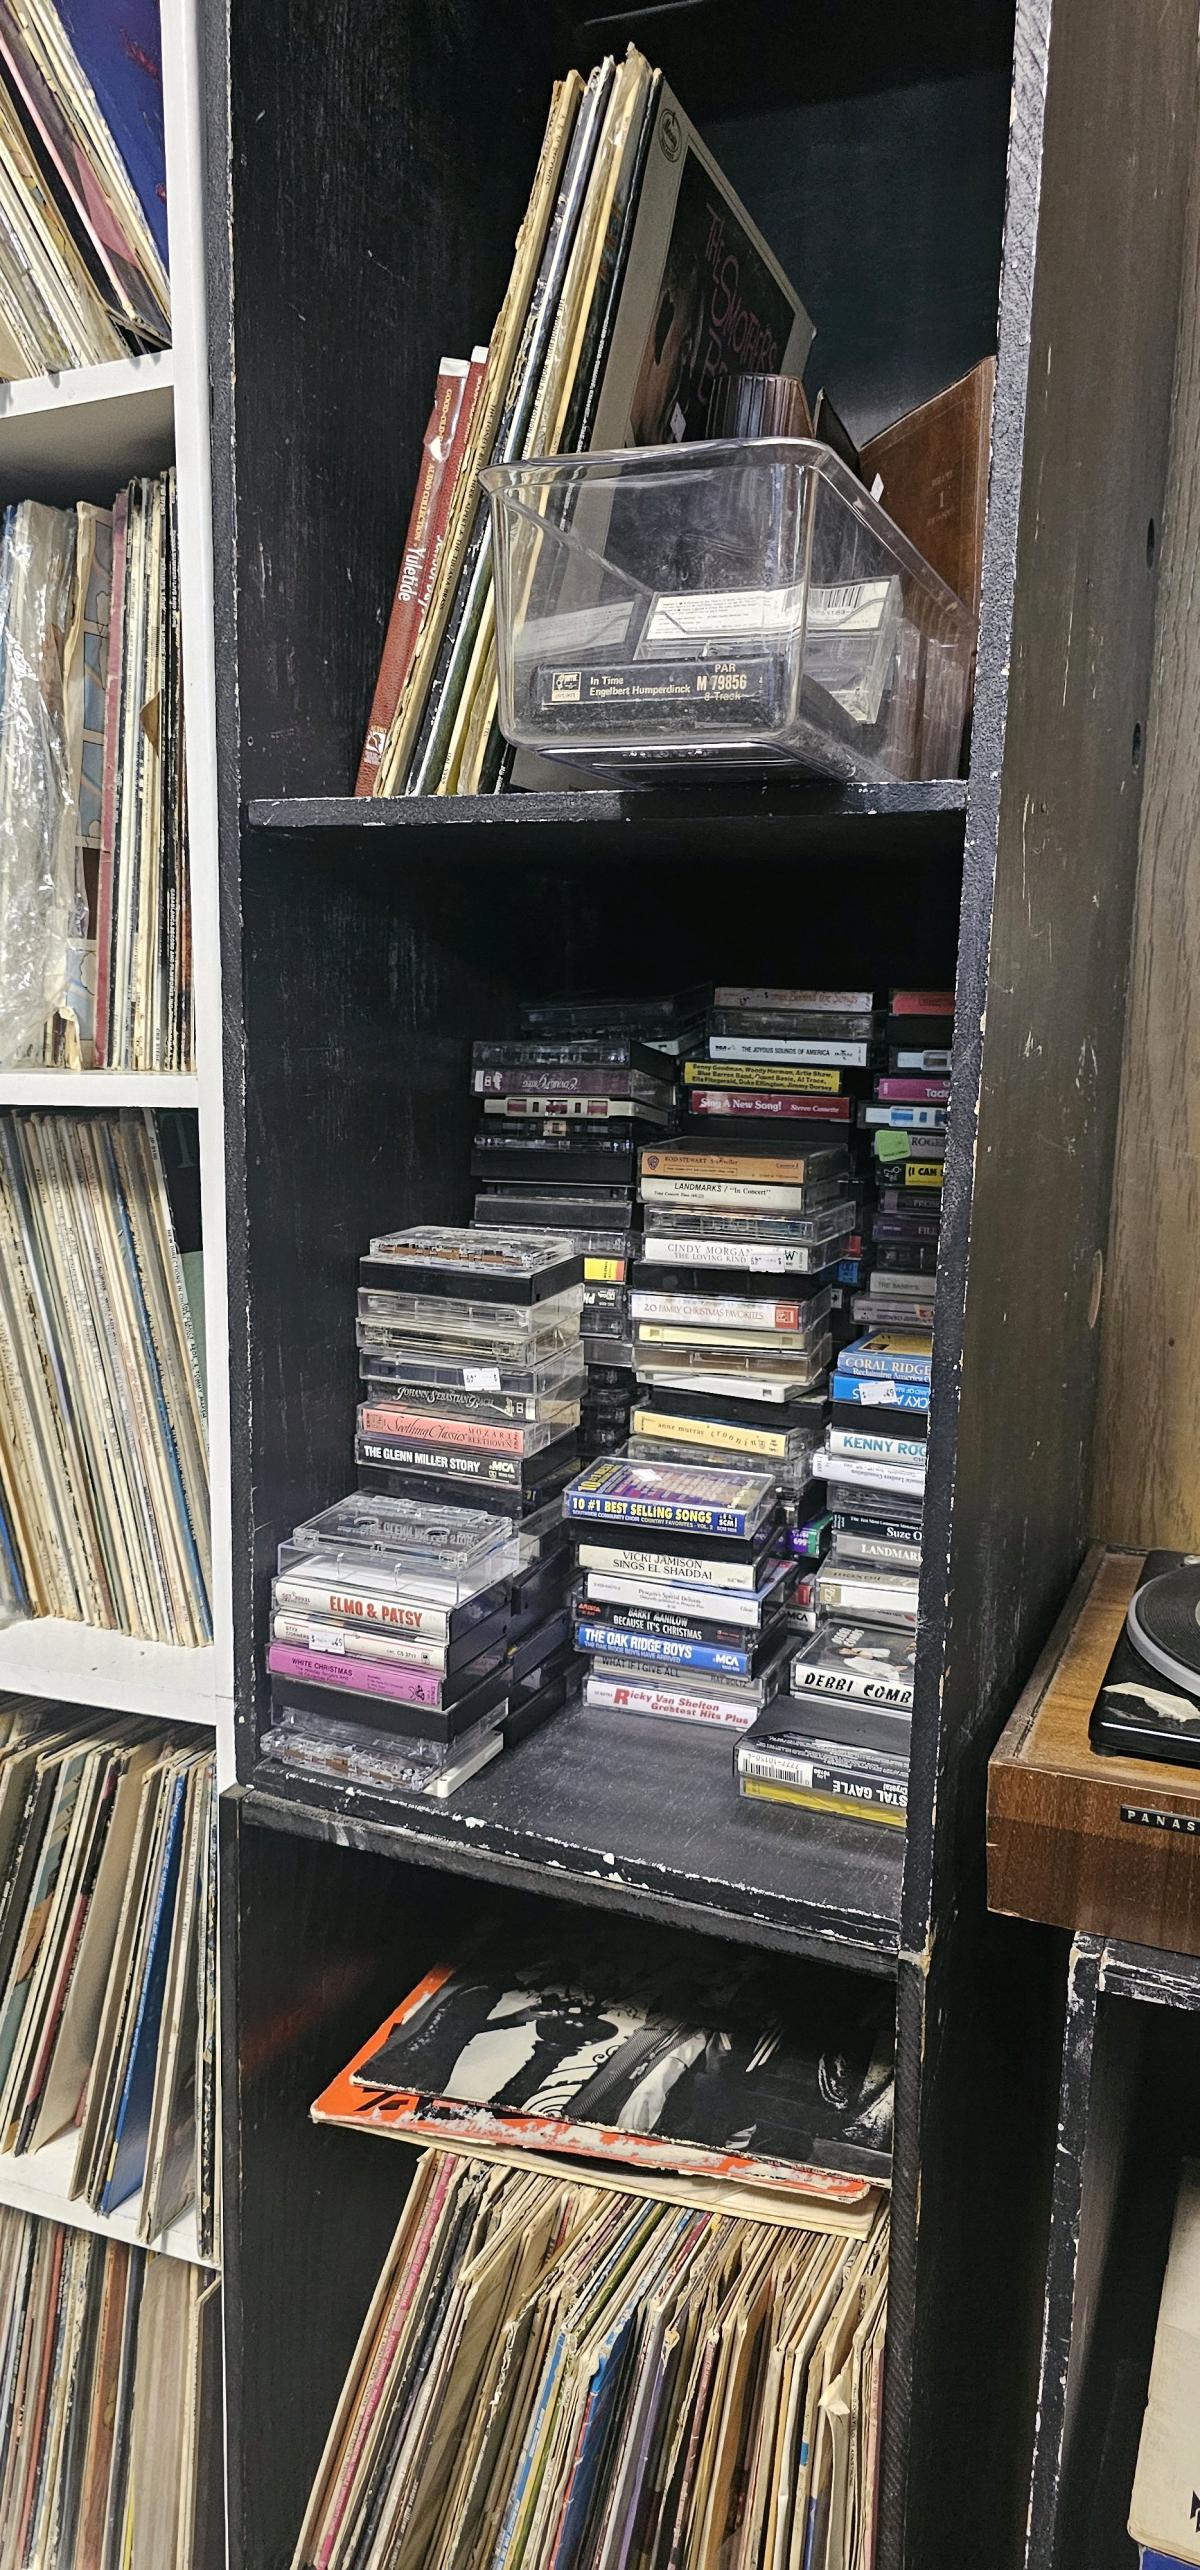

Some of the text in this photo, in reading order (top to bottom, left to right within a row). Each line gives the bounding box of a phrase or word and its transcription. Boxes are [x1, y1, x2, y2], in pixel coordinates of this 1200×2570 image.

[425, 463, 436, 490] AUDIO
[414, 487, 433, 541] COLLECTION
[398, 548, 427, 602] Yuletide
[715, 664, 736, 672] PAR
[589, 686, 630, 697] Engelbert
[632, 684, 691, 695] Humperdinck
[590, 674, 747, 690] In Time M 79856
[705, 1077, 738, 1085] Fitzgerald,
[755, 1080, 786, 1088] Ellington,
[813, 1070, 833, 1078] Shaw,
[699, 1098, 721, 1110] Sing
[723, 1099, 731, 1107] A
[733, 1100, 753, 1108] New
[755, 1101, 782, 1112] Song!
[908, 1167, 937, 1177] (I CAN
[675, 1182, 722, 1192] LANDMARKS
[668, 1244, 701, 1254] CINDY
[693, 1254, 723, 1262] LOVING
[643, 1303, 764, 1320] 20 FAMILY CHRISTMAS FAVORITES
[845, 1357, 931, 1376] CORAL RIDGE
[853, 1368, 892, 1379] Reclaiming
[393, 1387, 429, 1400] JOHANN
[427, 1389, 469, 1403] SEBASTIAN
[429, 1425, 467, 1441] Classics
[468, 1428, 512, 1440] MOZART
[658, 1422, 704, 1437] anne murray
[469, 1435, 512, 1448] BEETHOVEN
[844, 1436, 893, 1453] KENNY
[364, 1445, 514, 1473] THE GLENN MILLER STORY MCA
[573, 1498, 712, 1523] 10 #1 BEST SELLING SONGS
[641, 1517, 664, 1525] COUNTRY
[665, 1520, 693, 1528] FAVORITES
[887, 1527, 911, 1539] Suze
[623, 1551, 703, 1569] VICKI JAMISON
[613, 1559, 712, 1580] SINGS EL SHADDAI
[330, 1595, 363, 1617] ELMO
[367, 1605, 377, 1617] &
[382, 1605, 423, 1627] PATSY
[628, 1608, 688, 1626] BARRY MANILOW
[788, 1611, 808, 1622] MCA
[613, 1615, 644, 1629] BECAUSE
[646, 1621, 660, 1632] IT'S
[663, 1625, 702, 1639] CHRISTMAS
[585, 1628, 738, 1666] THE OAK RIDGE BOYS MCA
[625, 1647, 640, 1655] BOYS
[640, 1650, 656, 1659] HAVE
[657, 1653, 680, 1664] ARRIVED
[292, 1658, 353, 1676] WHITE CHRISTMAS
[602, 1657, 628, 1668] WHAT
[629, 1660, 635, 1669] IF
[641, 1662, 662, 1674] GIVE
[665, 1666, 680, 1678] ALL
[804, 1673, 912, 1704] DEBBI COMB
[613, 1688, 651, 1705] Ricky
[656, 1695, 674, 1704] Van
[678, 1696, 719, 1712] Shelton
[651, 1702, 748, 1725] Greatest Hits Plus
[833, 1780, 908, 1808] STAL GAYLE
[883, 1783, 908, 1795] Crystal
[1127, 1810, 1195, 1831] PANAS
